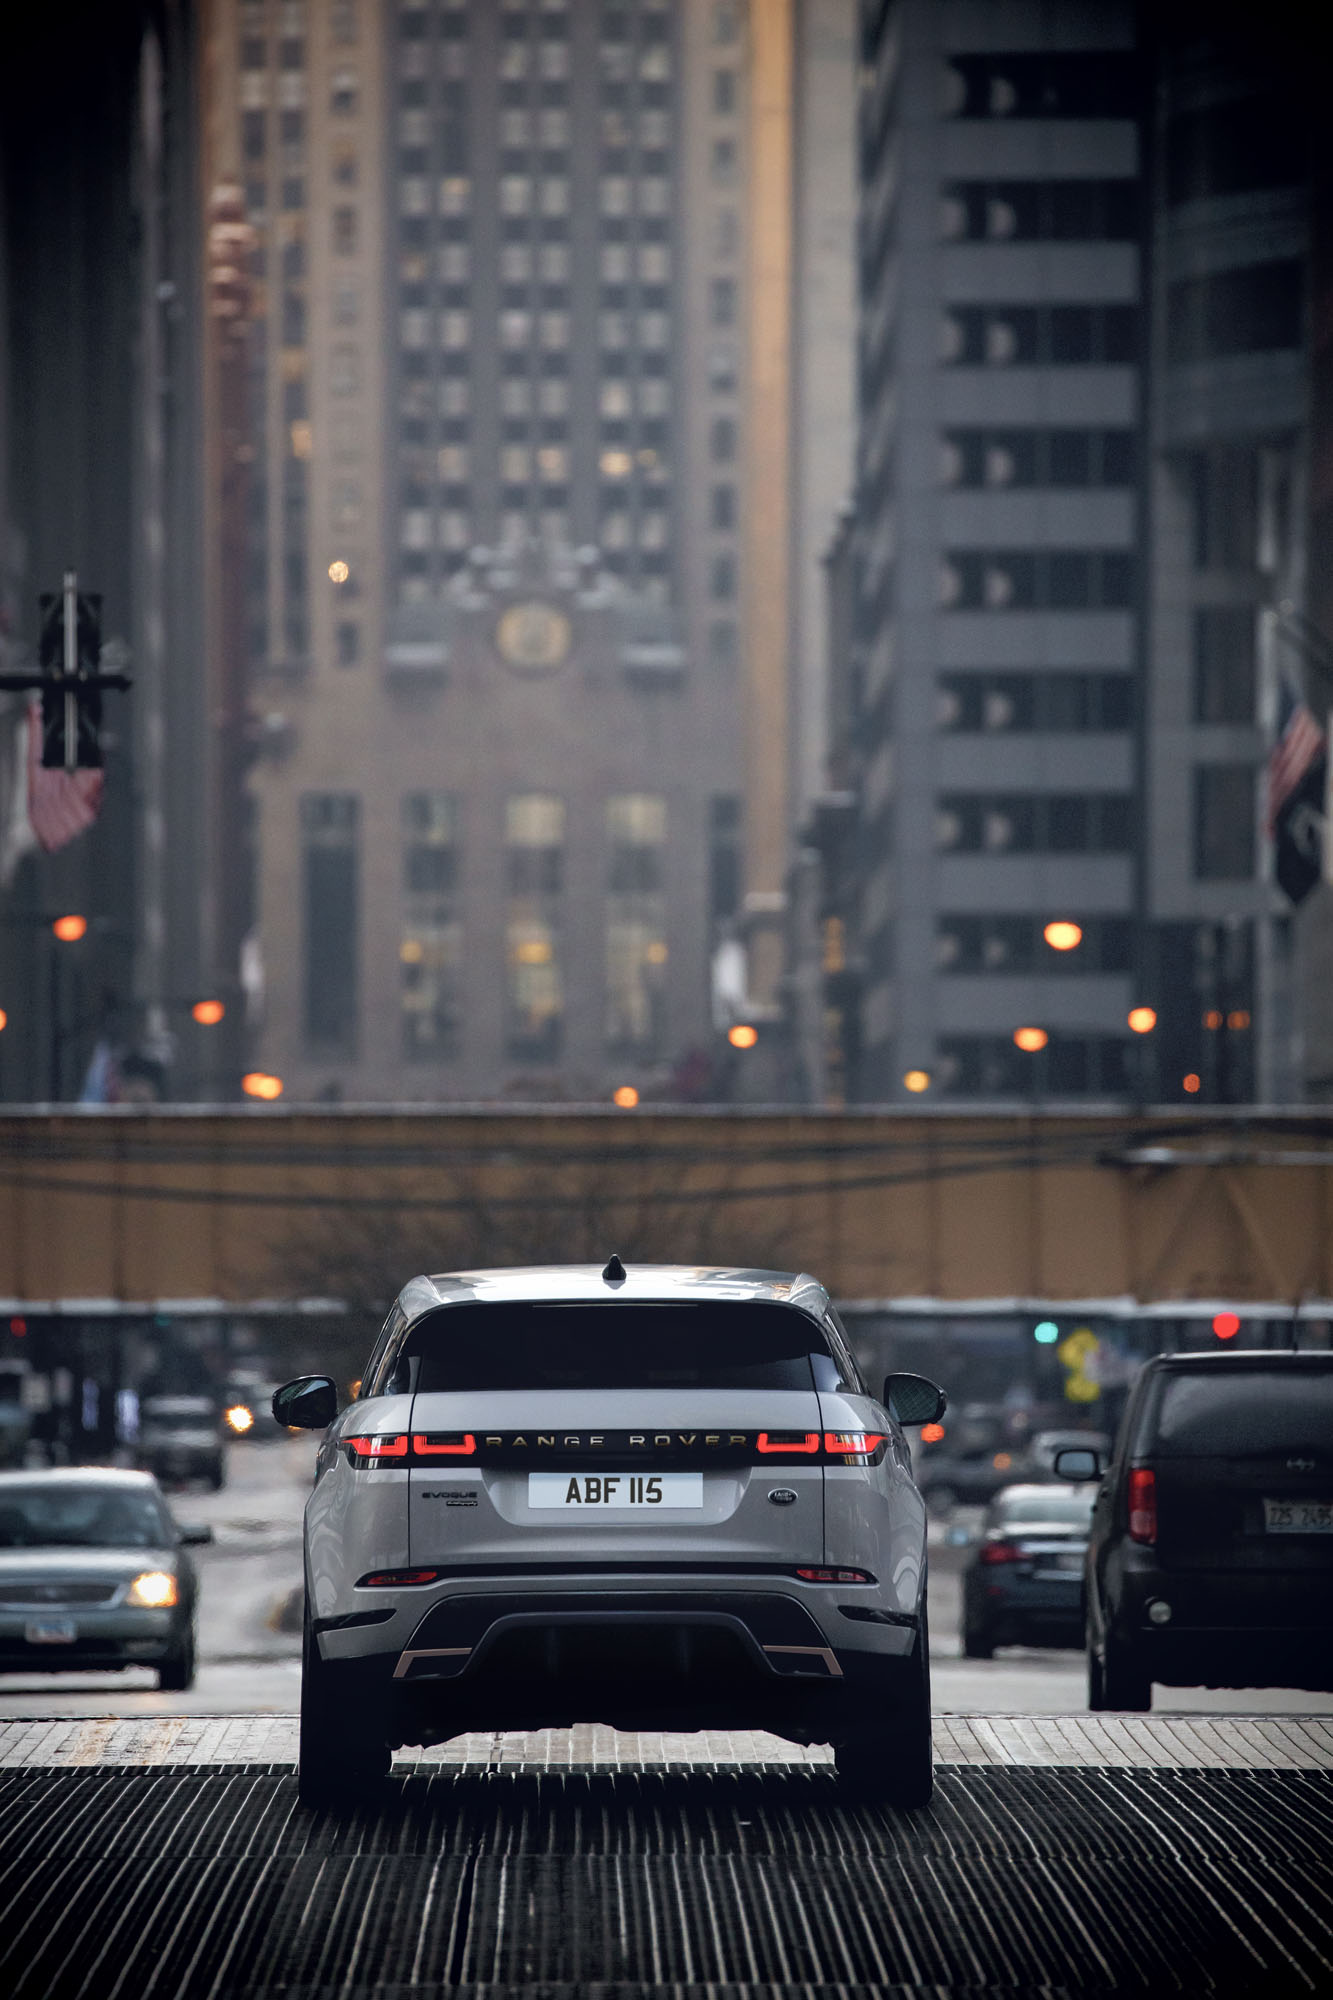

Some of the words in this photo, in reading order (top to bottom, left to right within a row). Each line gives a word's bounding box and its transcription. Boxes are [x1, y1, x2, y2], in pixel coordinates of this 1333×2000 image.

[486, 1436, 605, 1448] RANGE
[629, 1435, 748, 1447] ROVER
[422, 1491, 478, 1499] EVOQUE
[565, 1477, 621, 1504] ABF
[630, 1477, 663, 1504] 115
